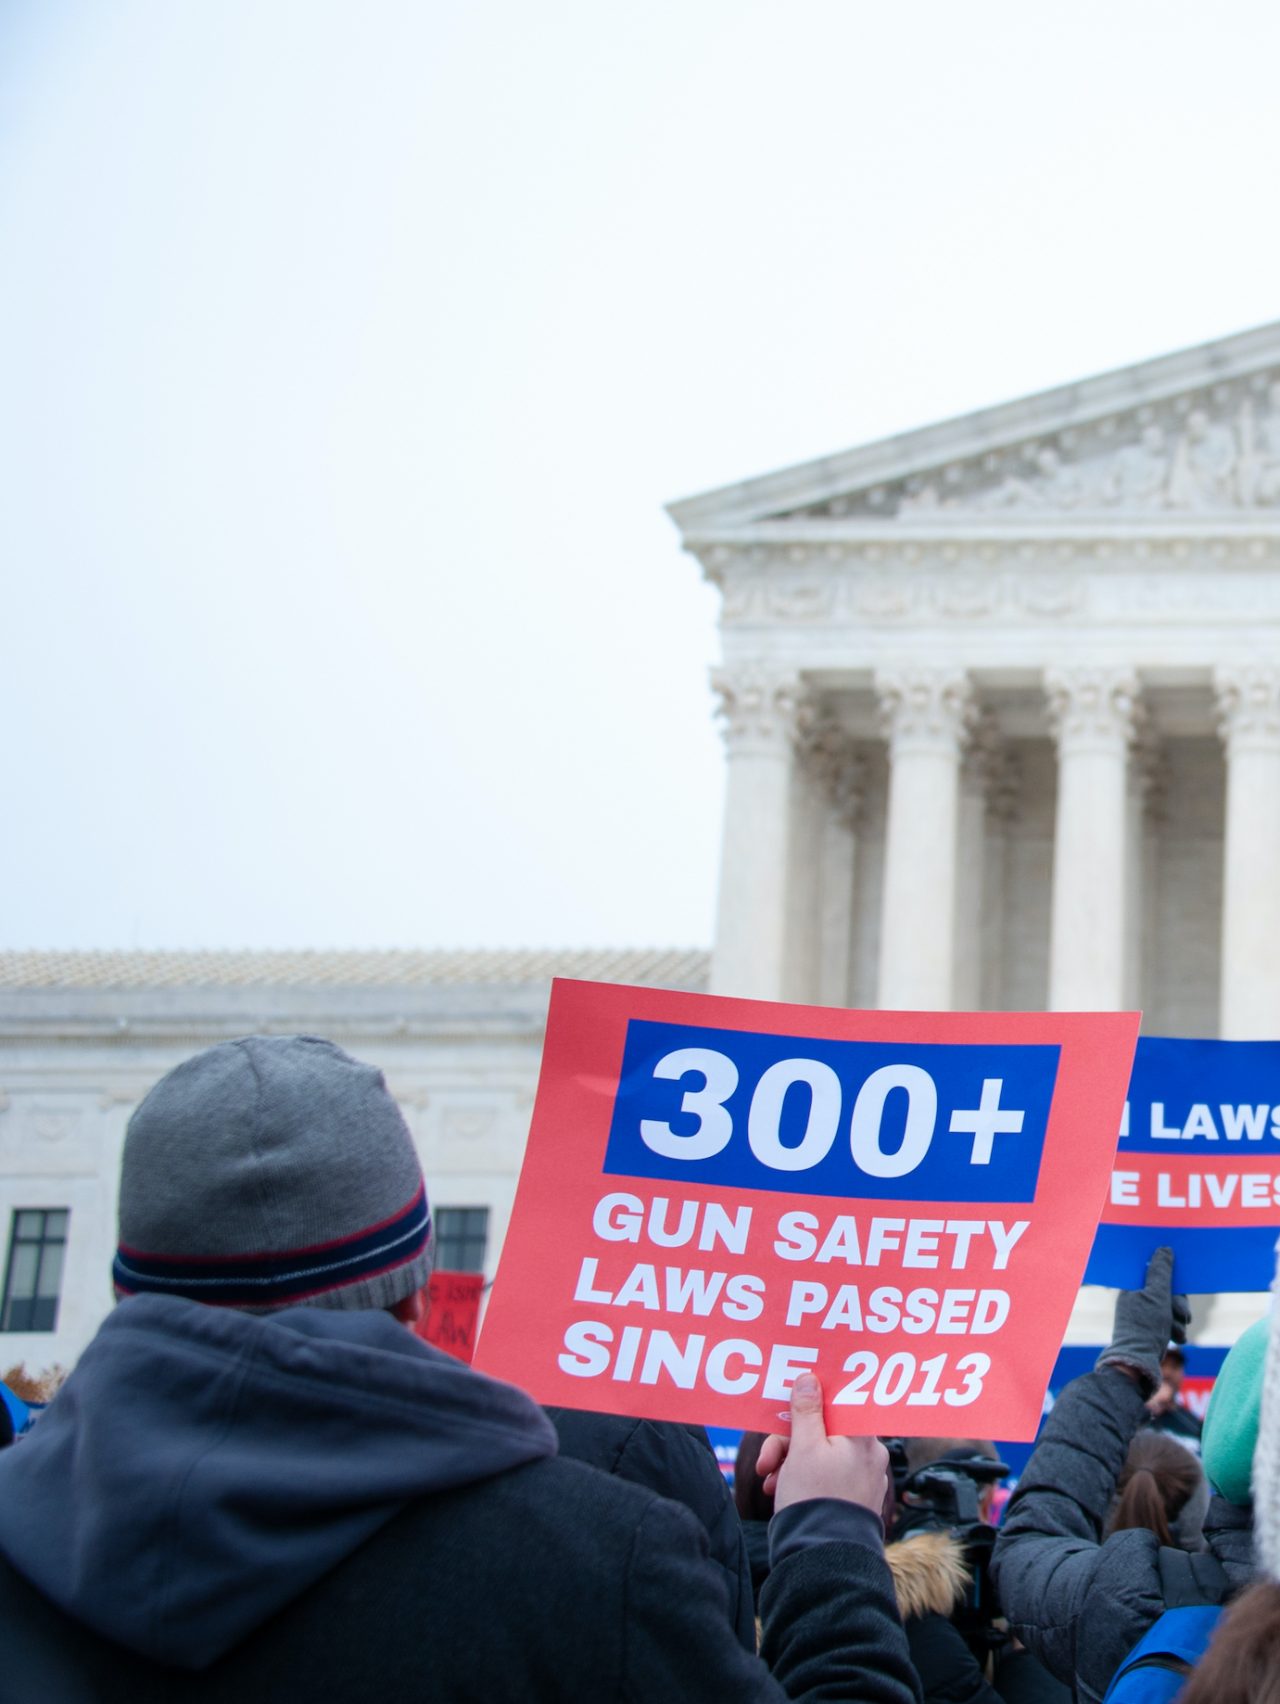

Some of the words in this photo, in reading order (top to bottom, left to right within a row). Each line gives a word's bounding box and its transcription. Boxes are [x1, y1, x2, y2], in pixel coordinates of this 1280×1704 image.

[640, 1048, 1025, 1178] 300+
[592, 1192, 752, 1255] GUN
[773, 1210, 1031, 1270] SAFETY
[573, 1257, 766, 1321] LAWS
[785, 1280, 1011, 1335] PASSED
[558, 1320, 819, 1402] SINCE
[832, 1350, 992, 1407] 2013
